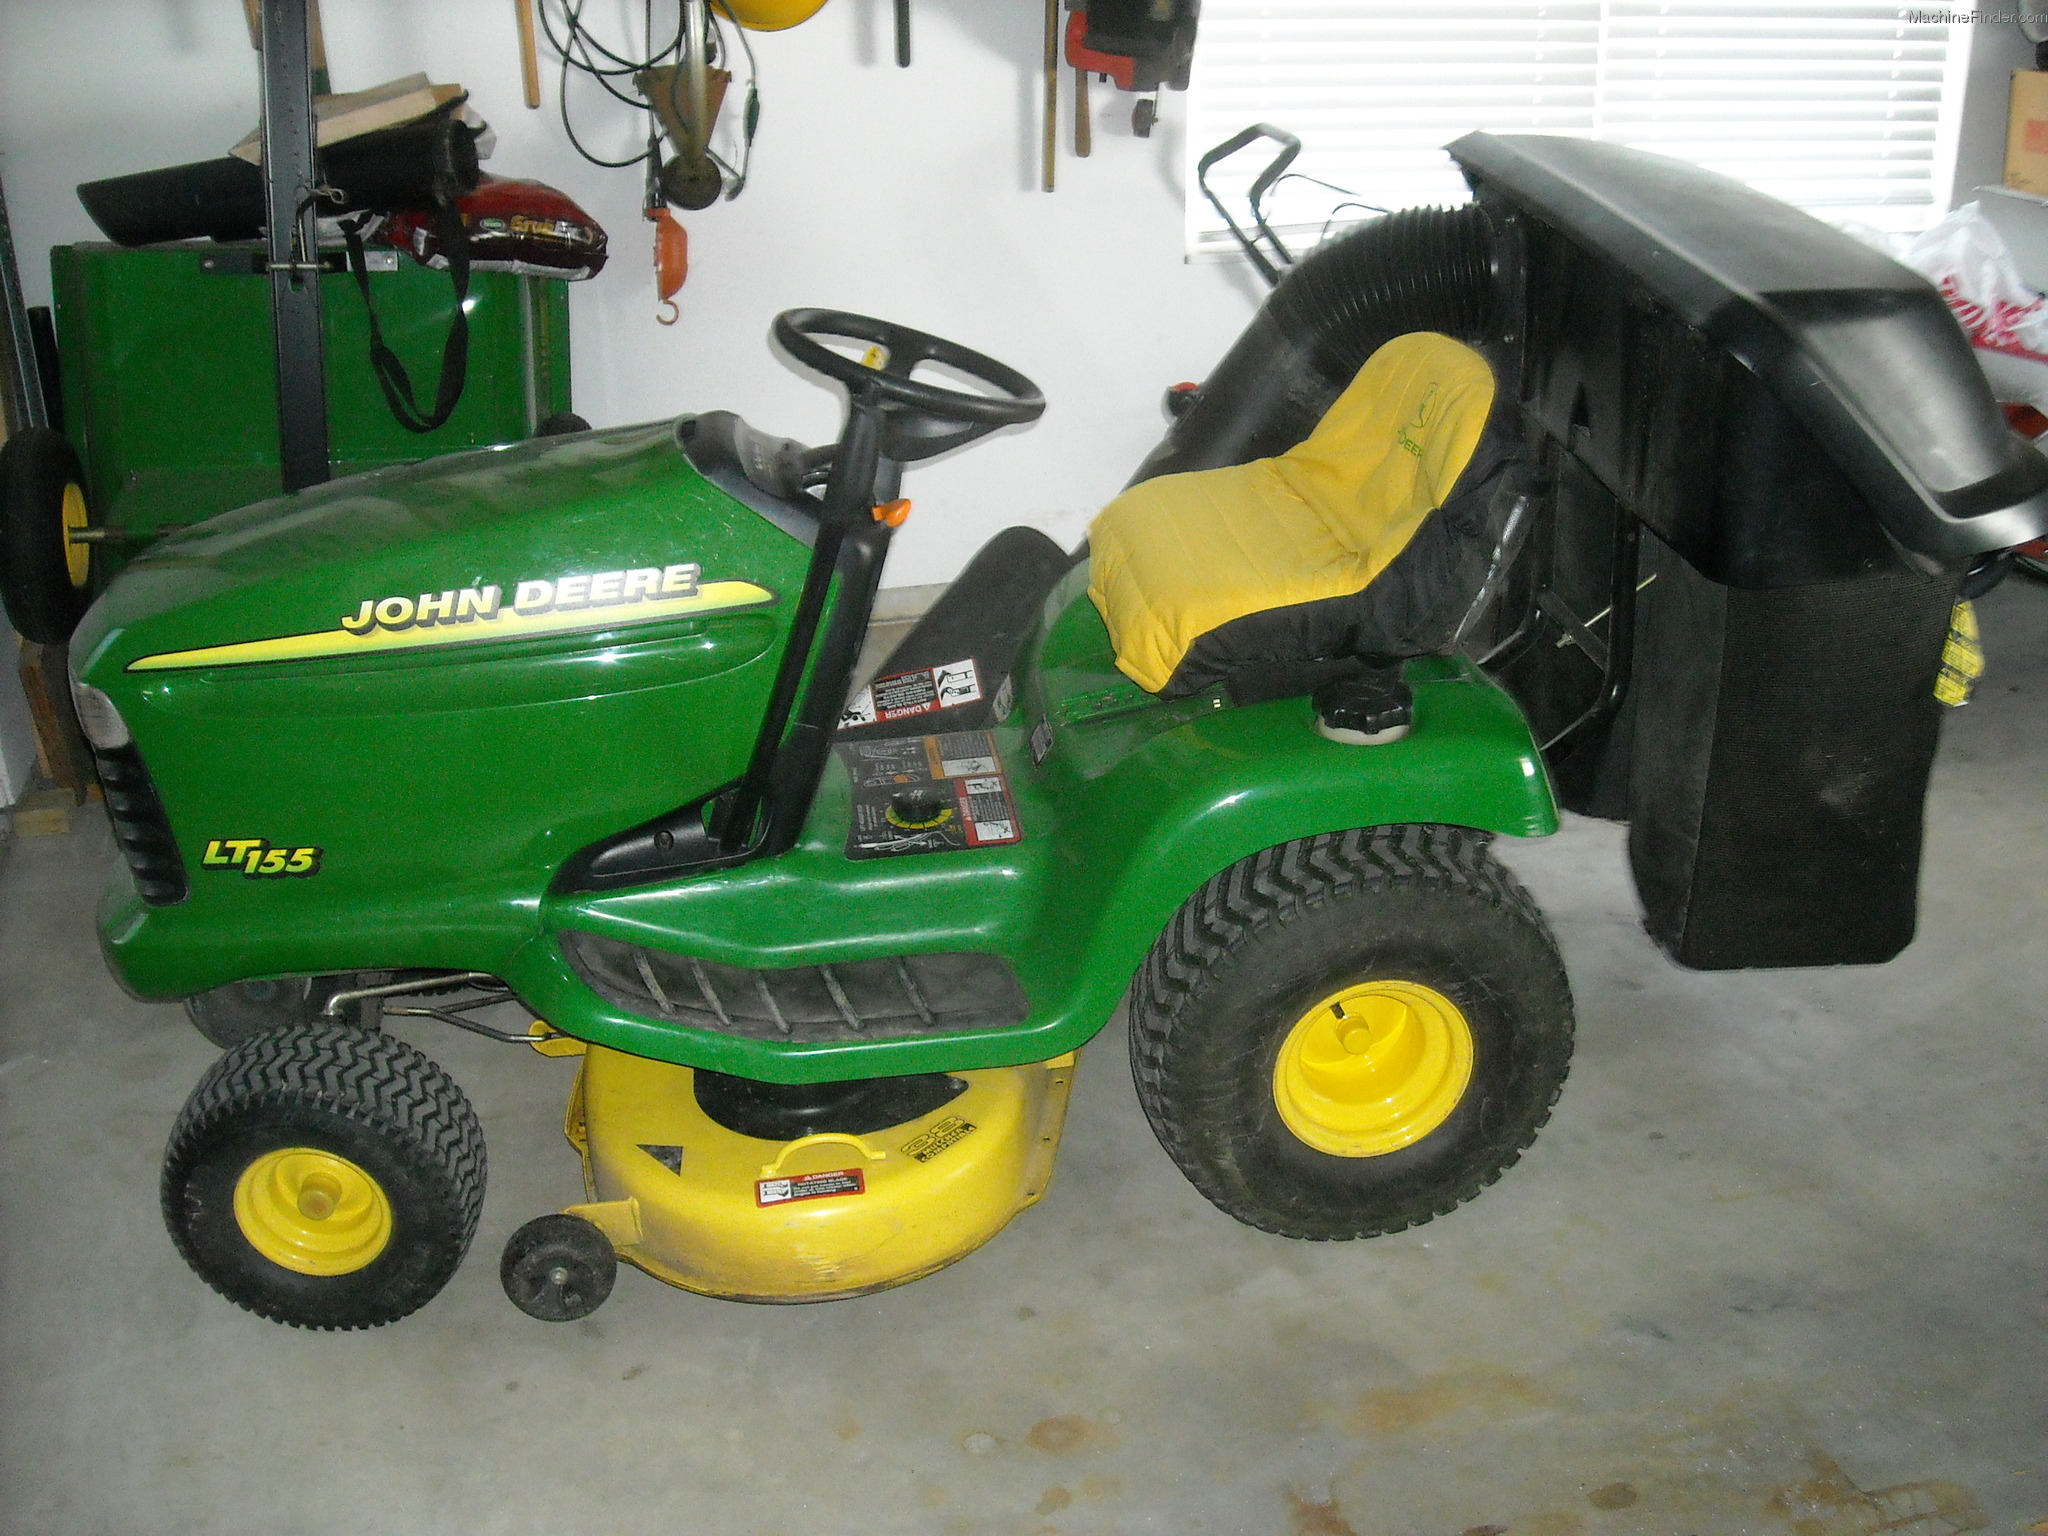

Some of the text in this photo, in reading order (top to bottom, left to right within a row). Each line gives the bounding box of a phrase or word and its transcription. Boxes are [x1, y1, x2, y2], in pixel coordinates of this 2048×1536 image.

[341, 563, 700, 634] JOHN DEERE
[885, 704, 922, 719] DANGER
[901, 1116, 965, 1156] 38
[812, 1171, 845, 1181] DANGER
